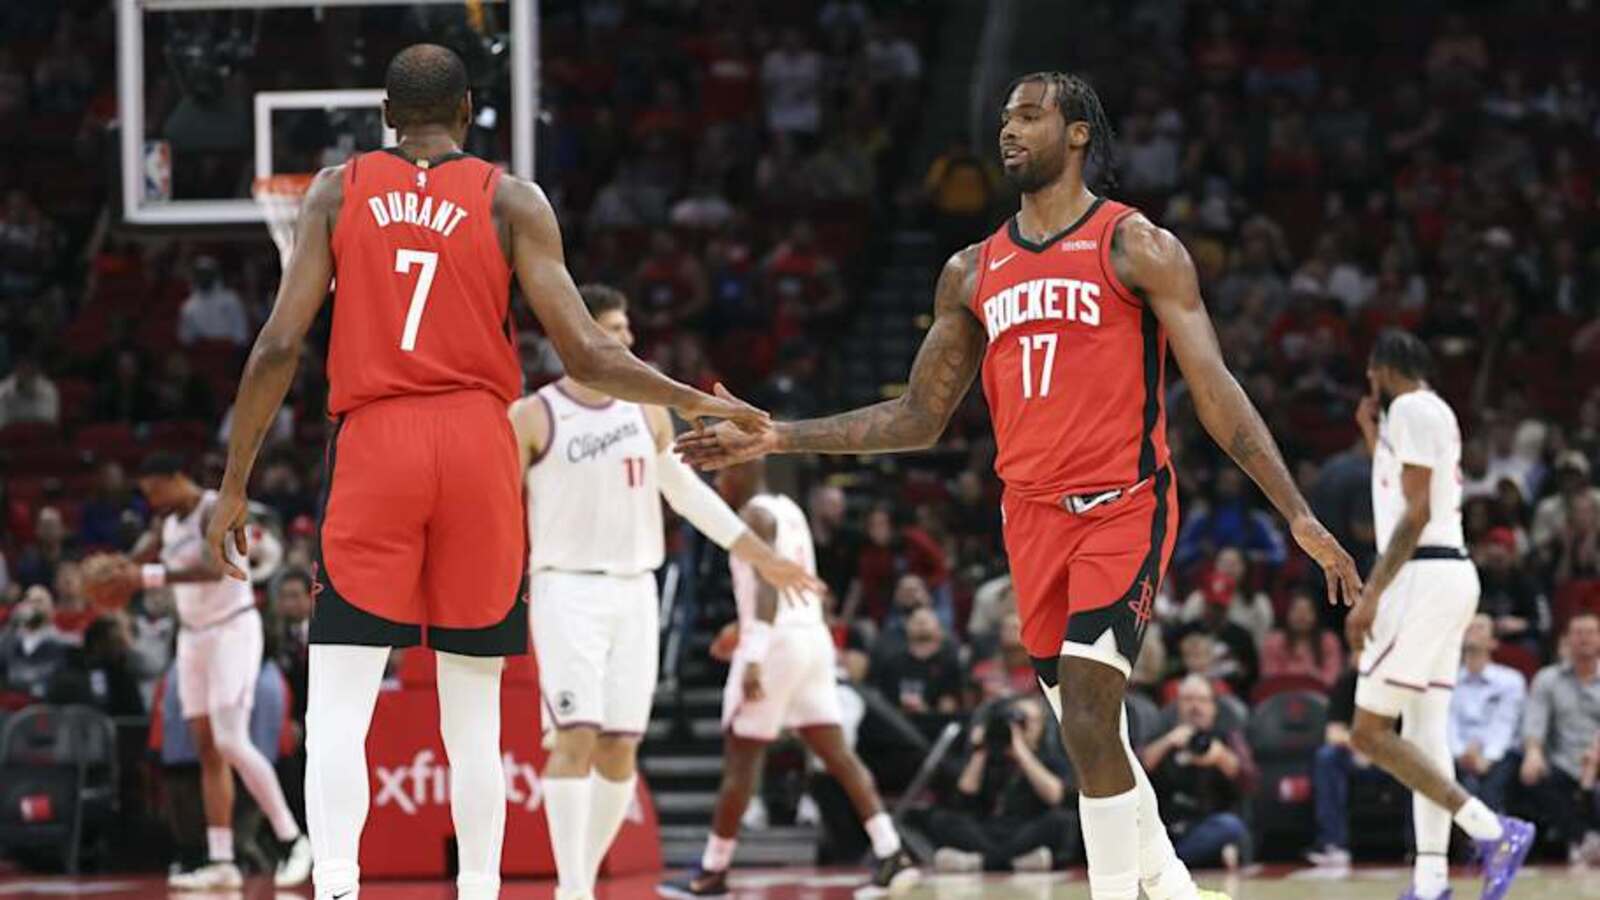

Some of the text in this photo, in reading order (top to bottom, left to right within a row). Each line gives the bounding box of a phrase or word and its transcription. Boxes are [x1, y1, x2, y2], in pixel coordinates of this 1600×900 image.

[368, 191, 468, 237] DURANT
[395, 248, 439, 352] 7
[983, 278, 1101, 343] ROCKETS
[1019, 333, 1058, 399] 17
[566, 422, 639, 464] Clippers
[623, 456, 646, 489] 11
[375, 749, 543, 815] xfity
